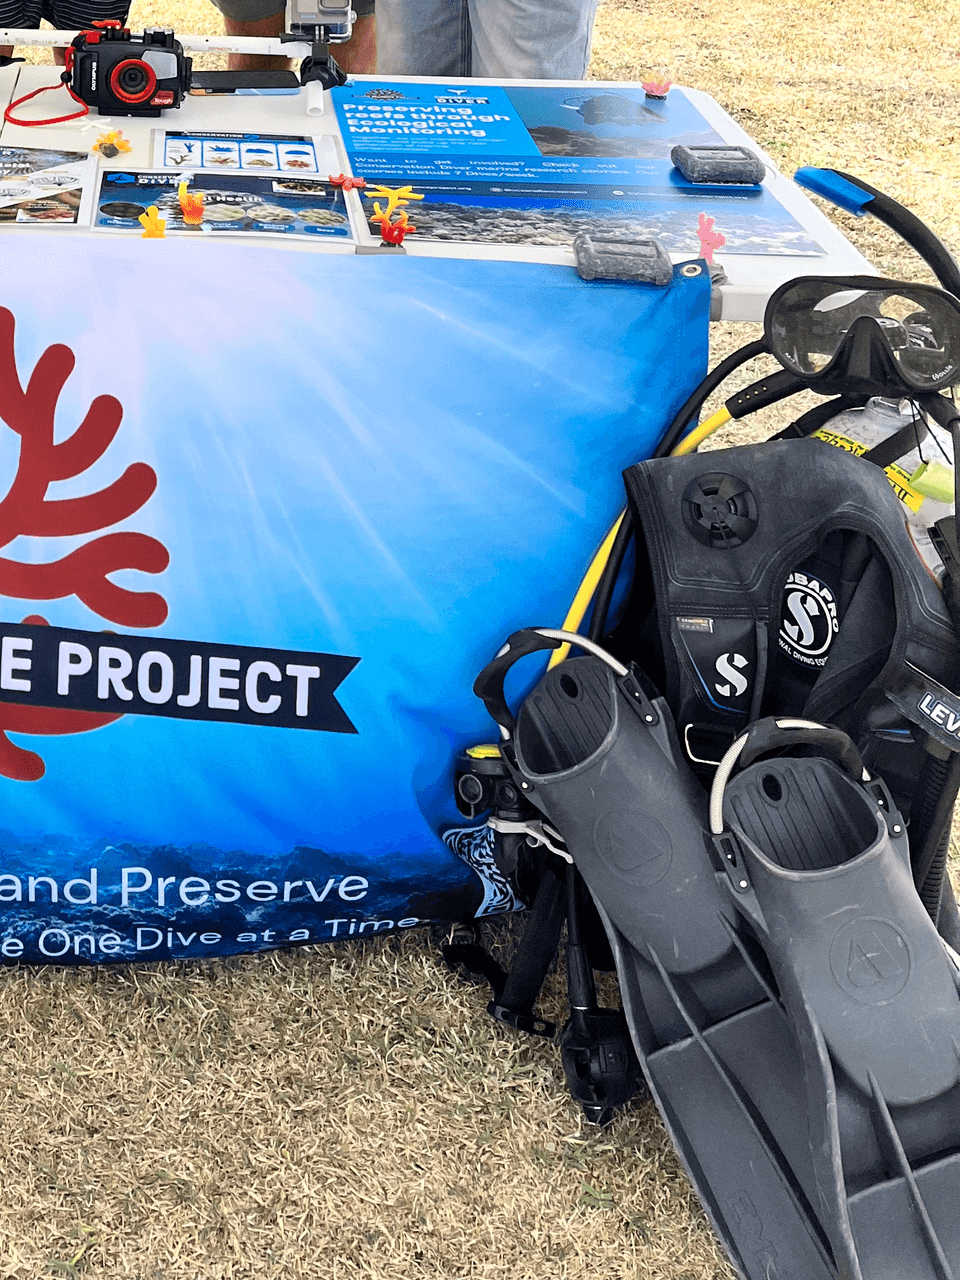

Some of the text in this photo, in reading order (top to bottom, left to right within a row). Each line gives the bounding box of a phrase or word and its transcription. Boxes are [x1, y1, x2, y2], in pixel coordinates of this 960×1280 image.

[343, 103, 472, 115] Preserving
[347, 119, 473, 129] Ecological
[411, 113, 511, 122] through
[350, 126, 487, 137] Monitoring
[793, 650, 815, 666] DIVING
[57, 640, 321, 717] PROJECT
[920, 694, 960, 738] LEV
[121, 866, 370, 907] Preserve
[38, 929, 122, 958] One
[136, 927, 221, 951] Dive
[236, 928, 277, 943] at
[288, 928, 310, 942] a
[325, 916, 420, 938] Time
